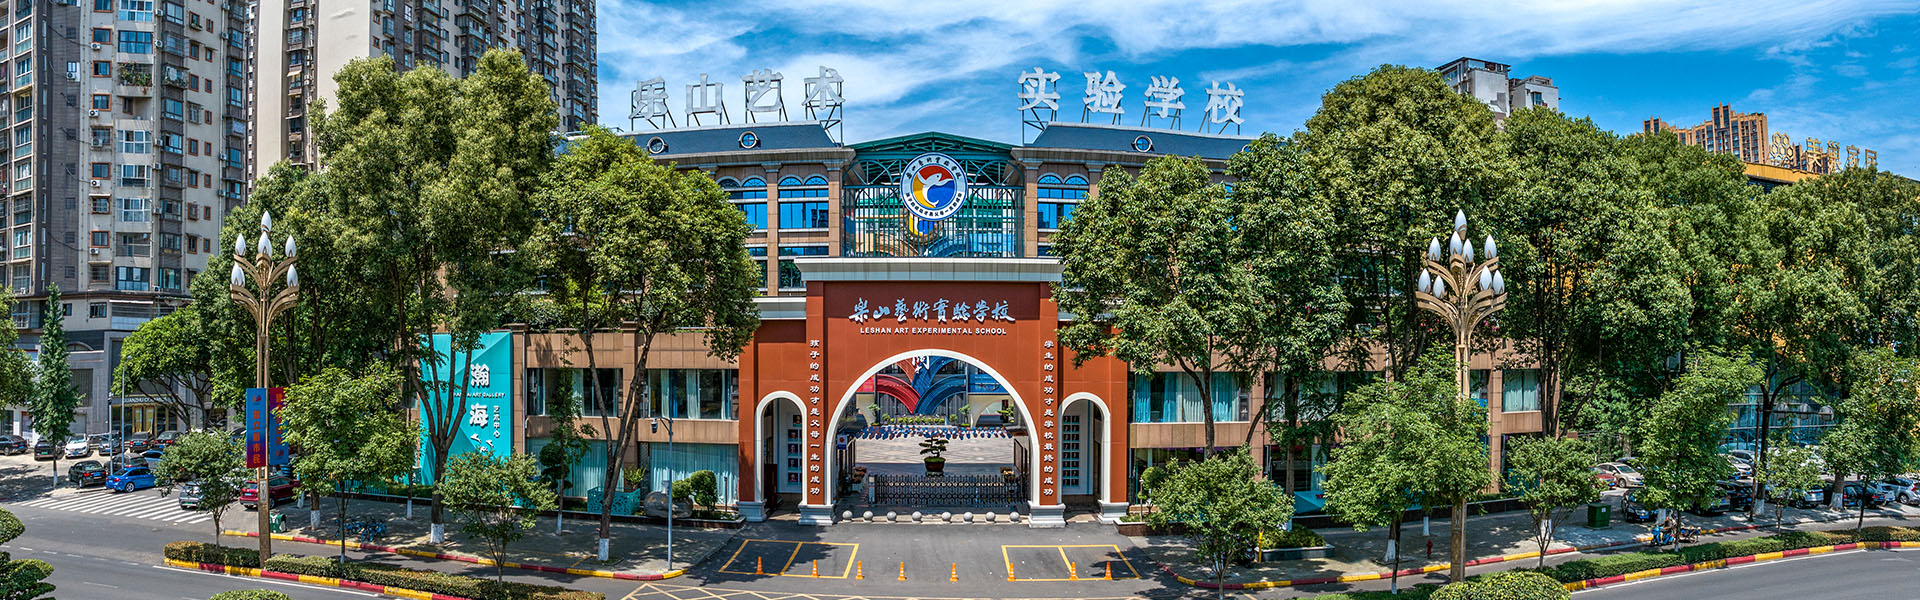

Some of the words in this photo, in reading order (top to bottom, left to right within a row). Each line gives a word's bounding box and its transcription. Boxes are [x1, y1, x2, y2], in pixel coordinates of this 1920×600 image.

[628, 66, 846, 119] 乐山艺术
[1017, 67, 1245, 125] 实验学校
[860, 327, 892, 335] LESHAN
[894, 327, 909, 335] ART
[912, 327, 973, 335] EXPERIMENTAL
[975, 327, 1007, 336] SCHOOL
[469, 363, 490, 427] 瀚海
[483, 391, 505, 399] GALLERY
[493, 405, 501, 438] 艺术中心
[810, 339, 820, 495] 孩子的成功才是父母一生的成功
[1043, 340, 1054, 496] 学生的成功才是学校最终的成功
